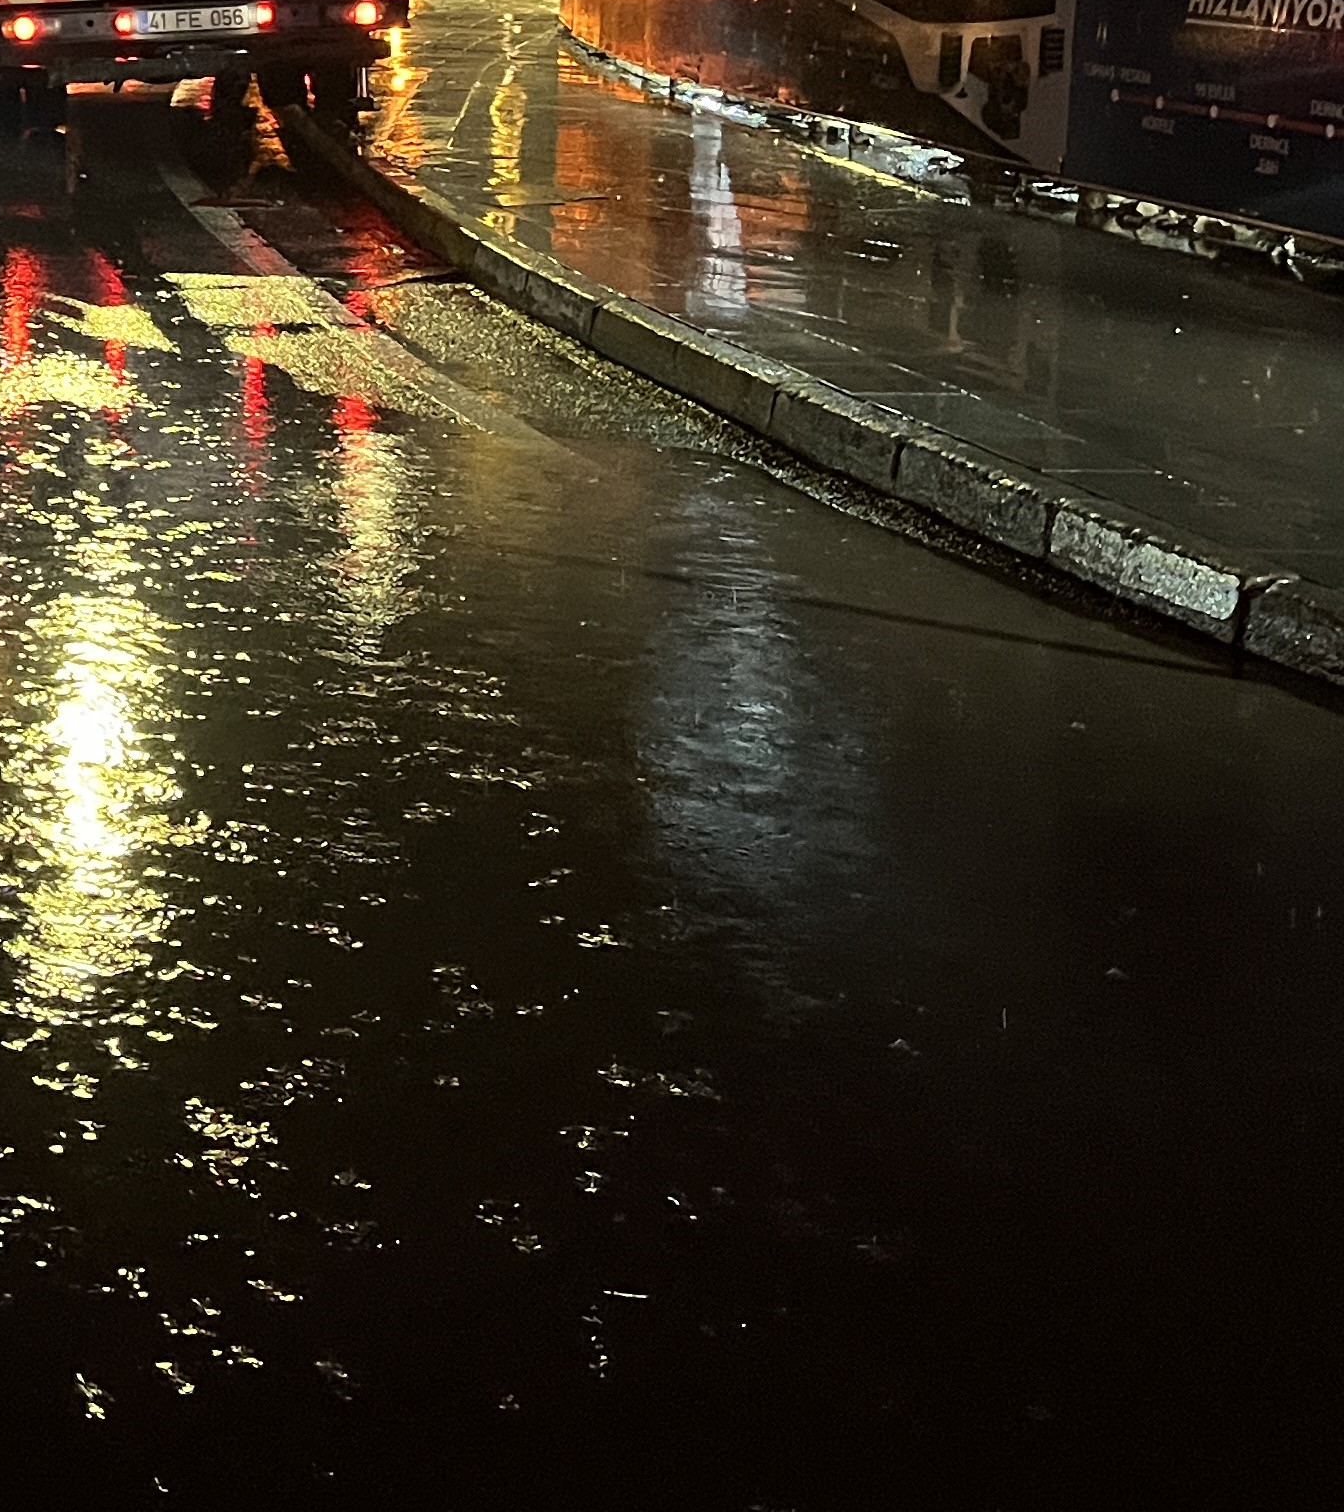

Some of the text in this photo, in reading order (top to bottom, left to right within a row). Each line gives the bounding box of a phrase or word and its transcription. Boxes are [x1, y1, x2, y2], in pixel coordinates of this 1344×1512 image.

[149, 9, 244, 30] 41 FE 056
